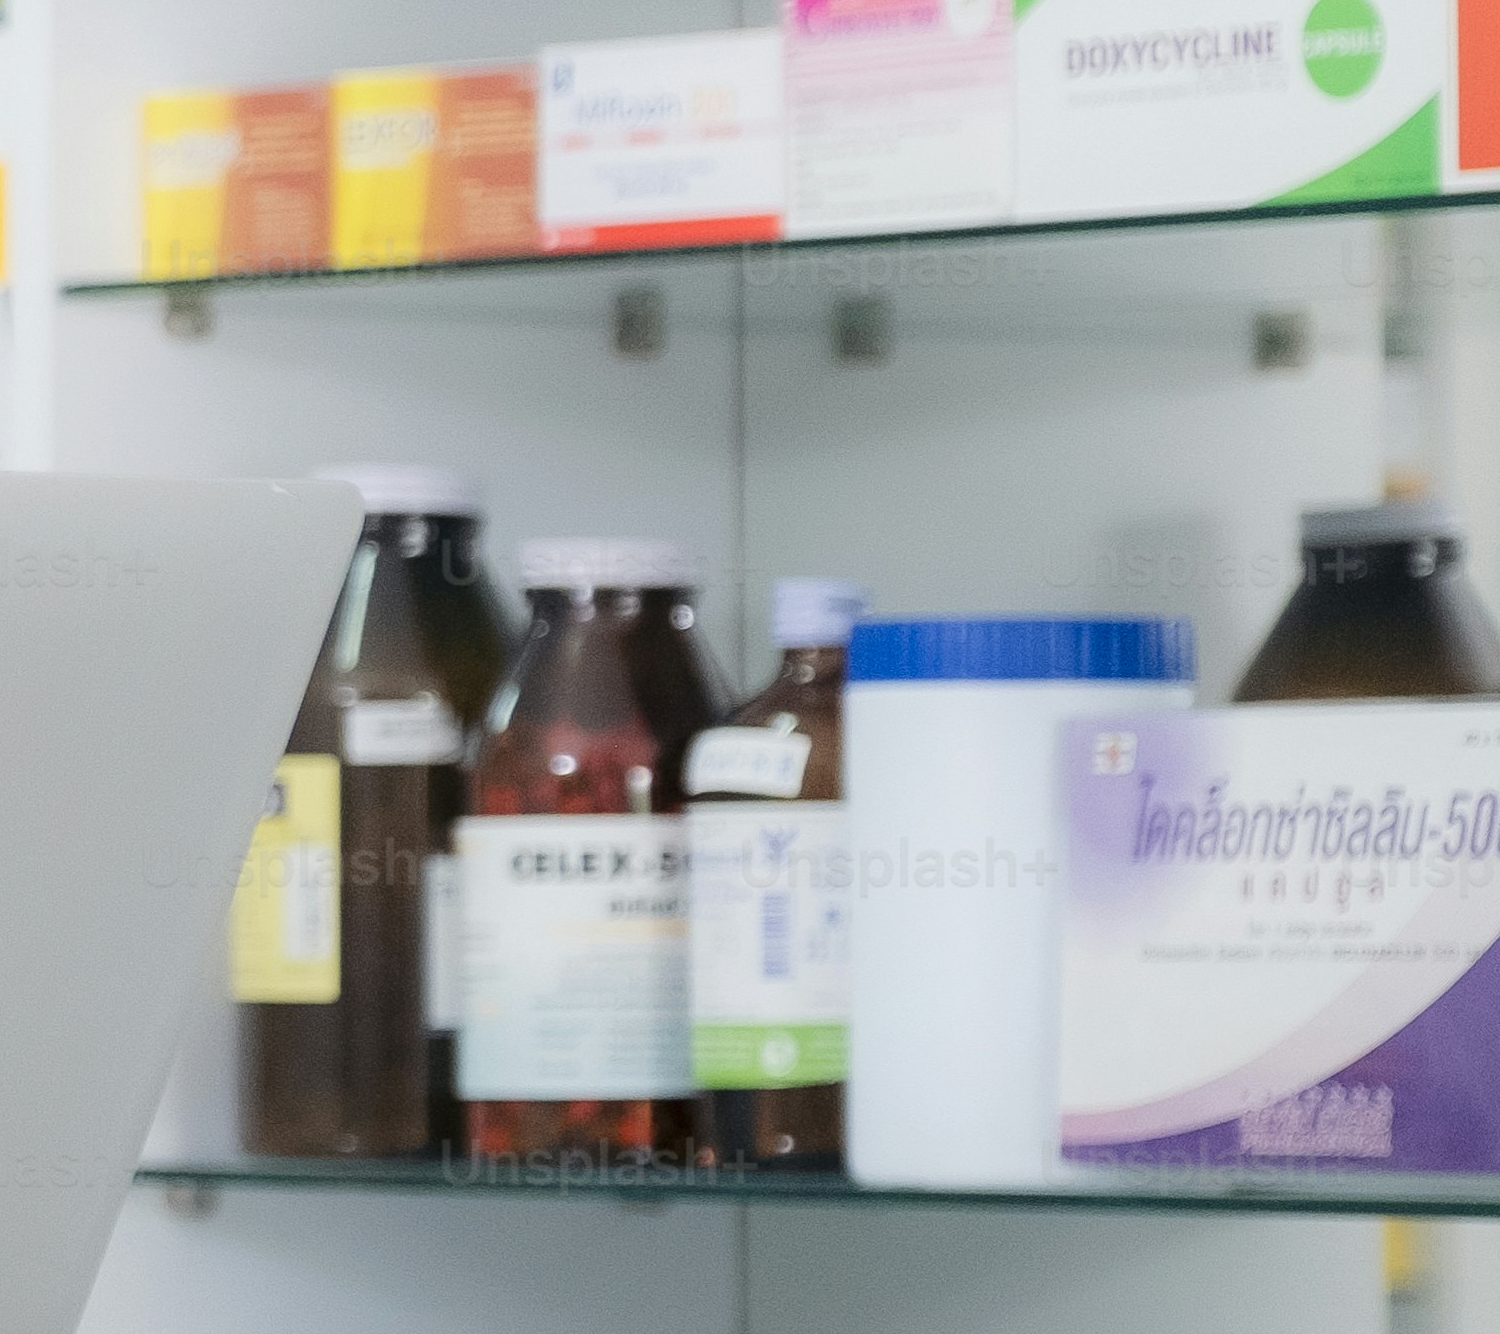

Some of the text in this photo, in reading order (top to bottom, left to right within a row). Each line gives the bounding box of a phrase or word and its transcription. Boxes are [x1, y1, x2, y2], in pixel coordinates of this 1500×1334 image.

[1065, 22, 1282, 79] DOXYCYCLINE
[1133, 771, 1500, 865] ไดคล็อกซ่าซิลลิน-50
